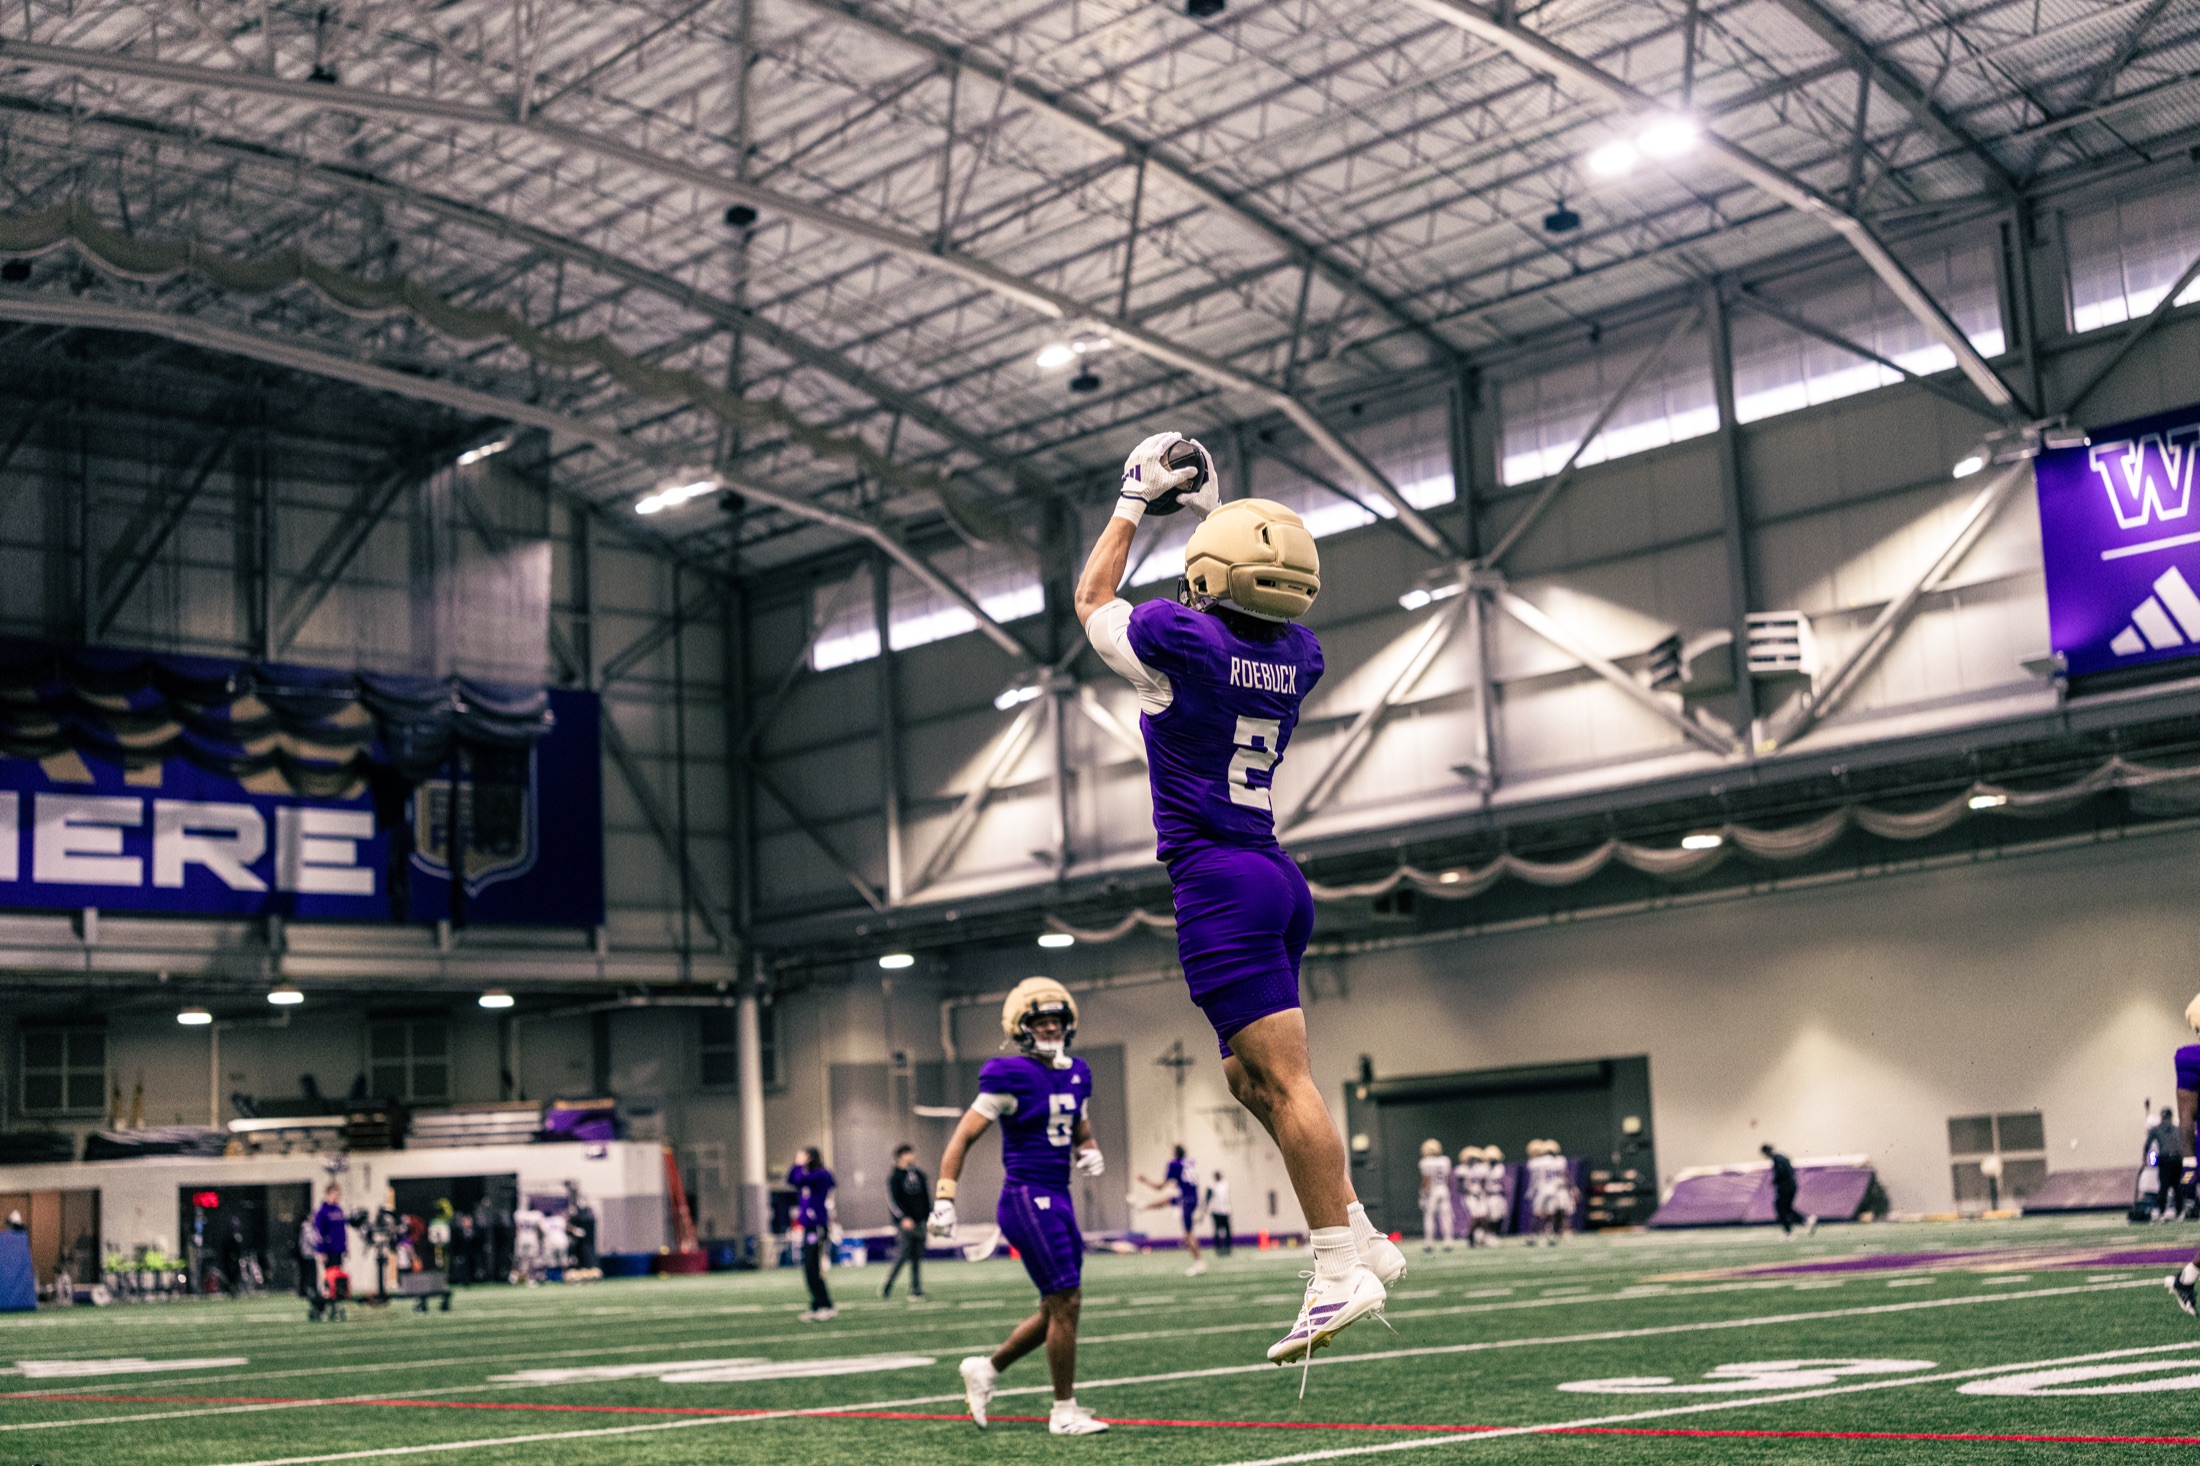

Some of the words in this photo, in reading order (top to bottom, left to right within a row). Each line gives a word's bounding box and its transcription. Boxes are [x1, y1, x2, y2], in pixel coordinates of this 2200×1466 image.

[2089, 422, 2200, 530] W
[1230, 656, 1297, 695] ROEBUCK
[1228, 715, 1281, 811] 2
[0, 791, 375, 896] ERE
[1046, 1093, 1077, 1147] 6
